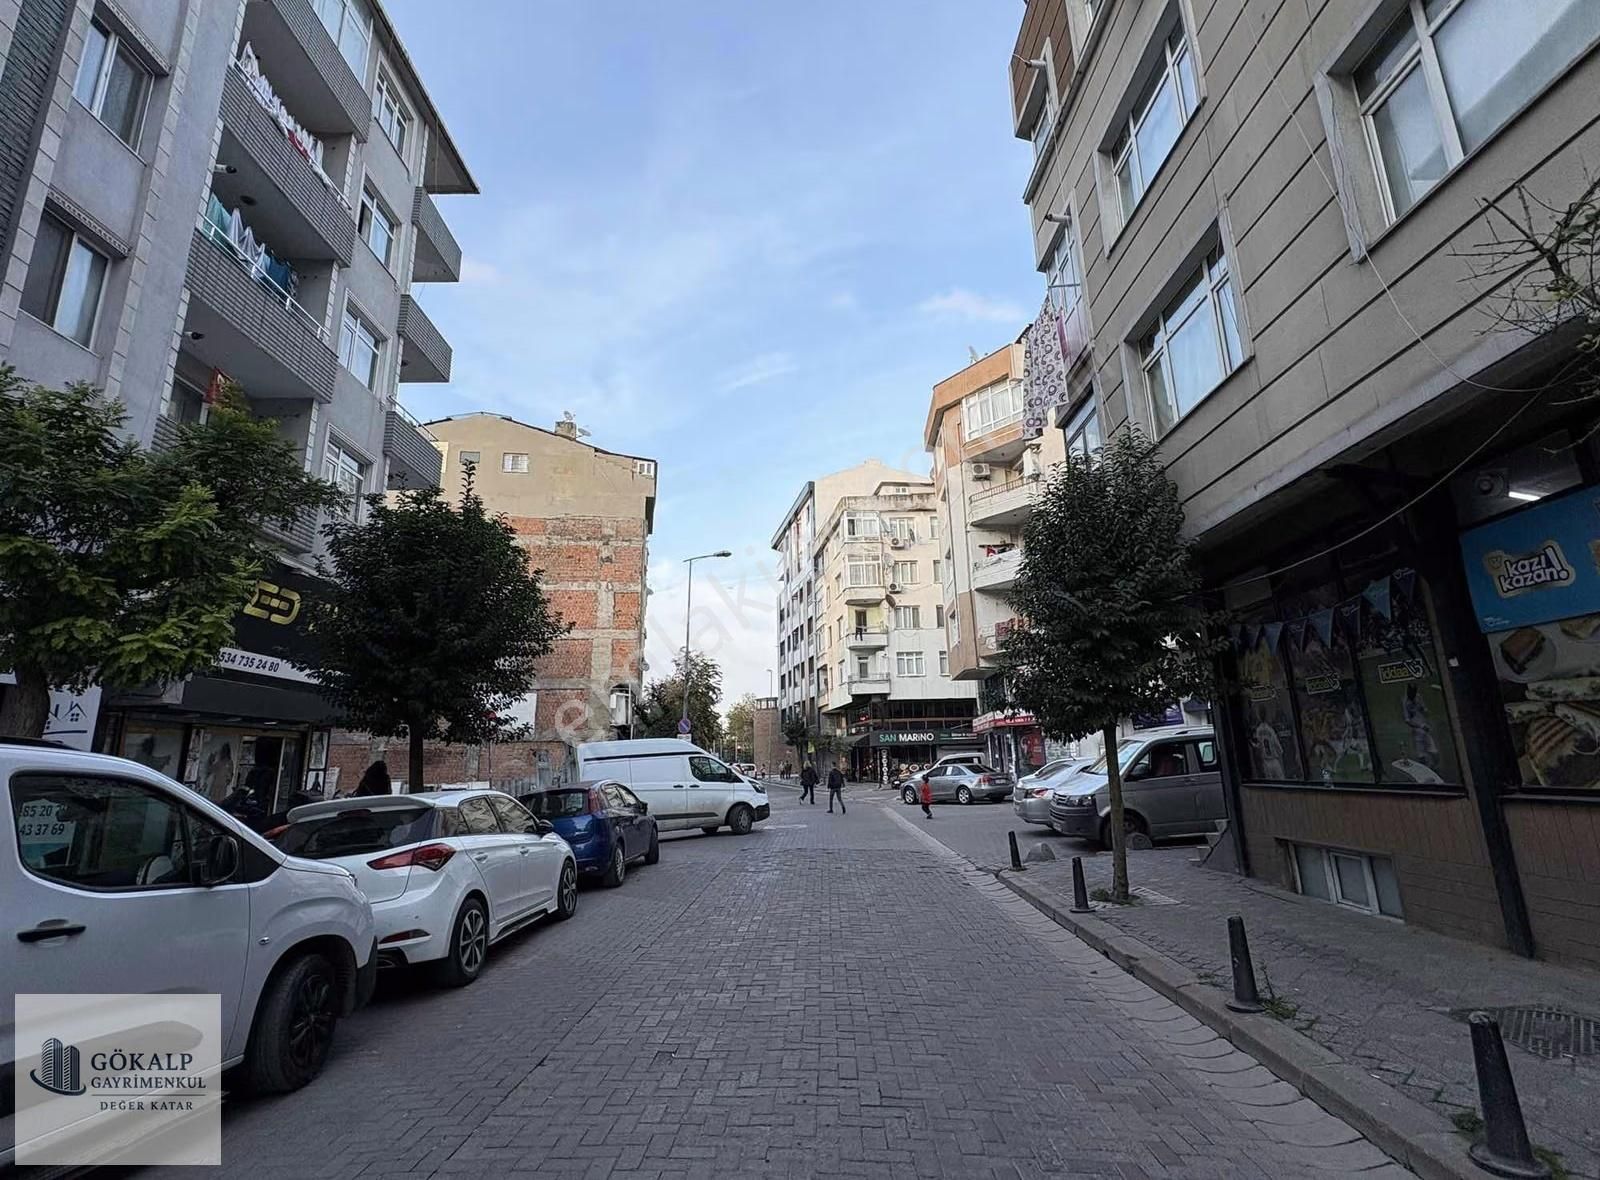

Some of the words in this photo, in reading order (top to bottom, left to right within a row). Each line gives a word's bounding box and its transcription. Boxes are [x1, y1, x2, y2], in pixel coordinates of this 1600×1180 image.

[238, 655, 256, 668] 735
[256, 659, 267, 670] 24
[268, 661, 280, 673] 80
[879, 734, 896, 742] SAN
[39, 805, 53, 817] 20
[35, 823, 49, 836] 37
[51, 823, 65, 835] 69
